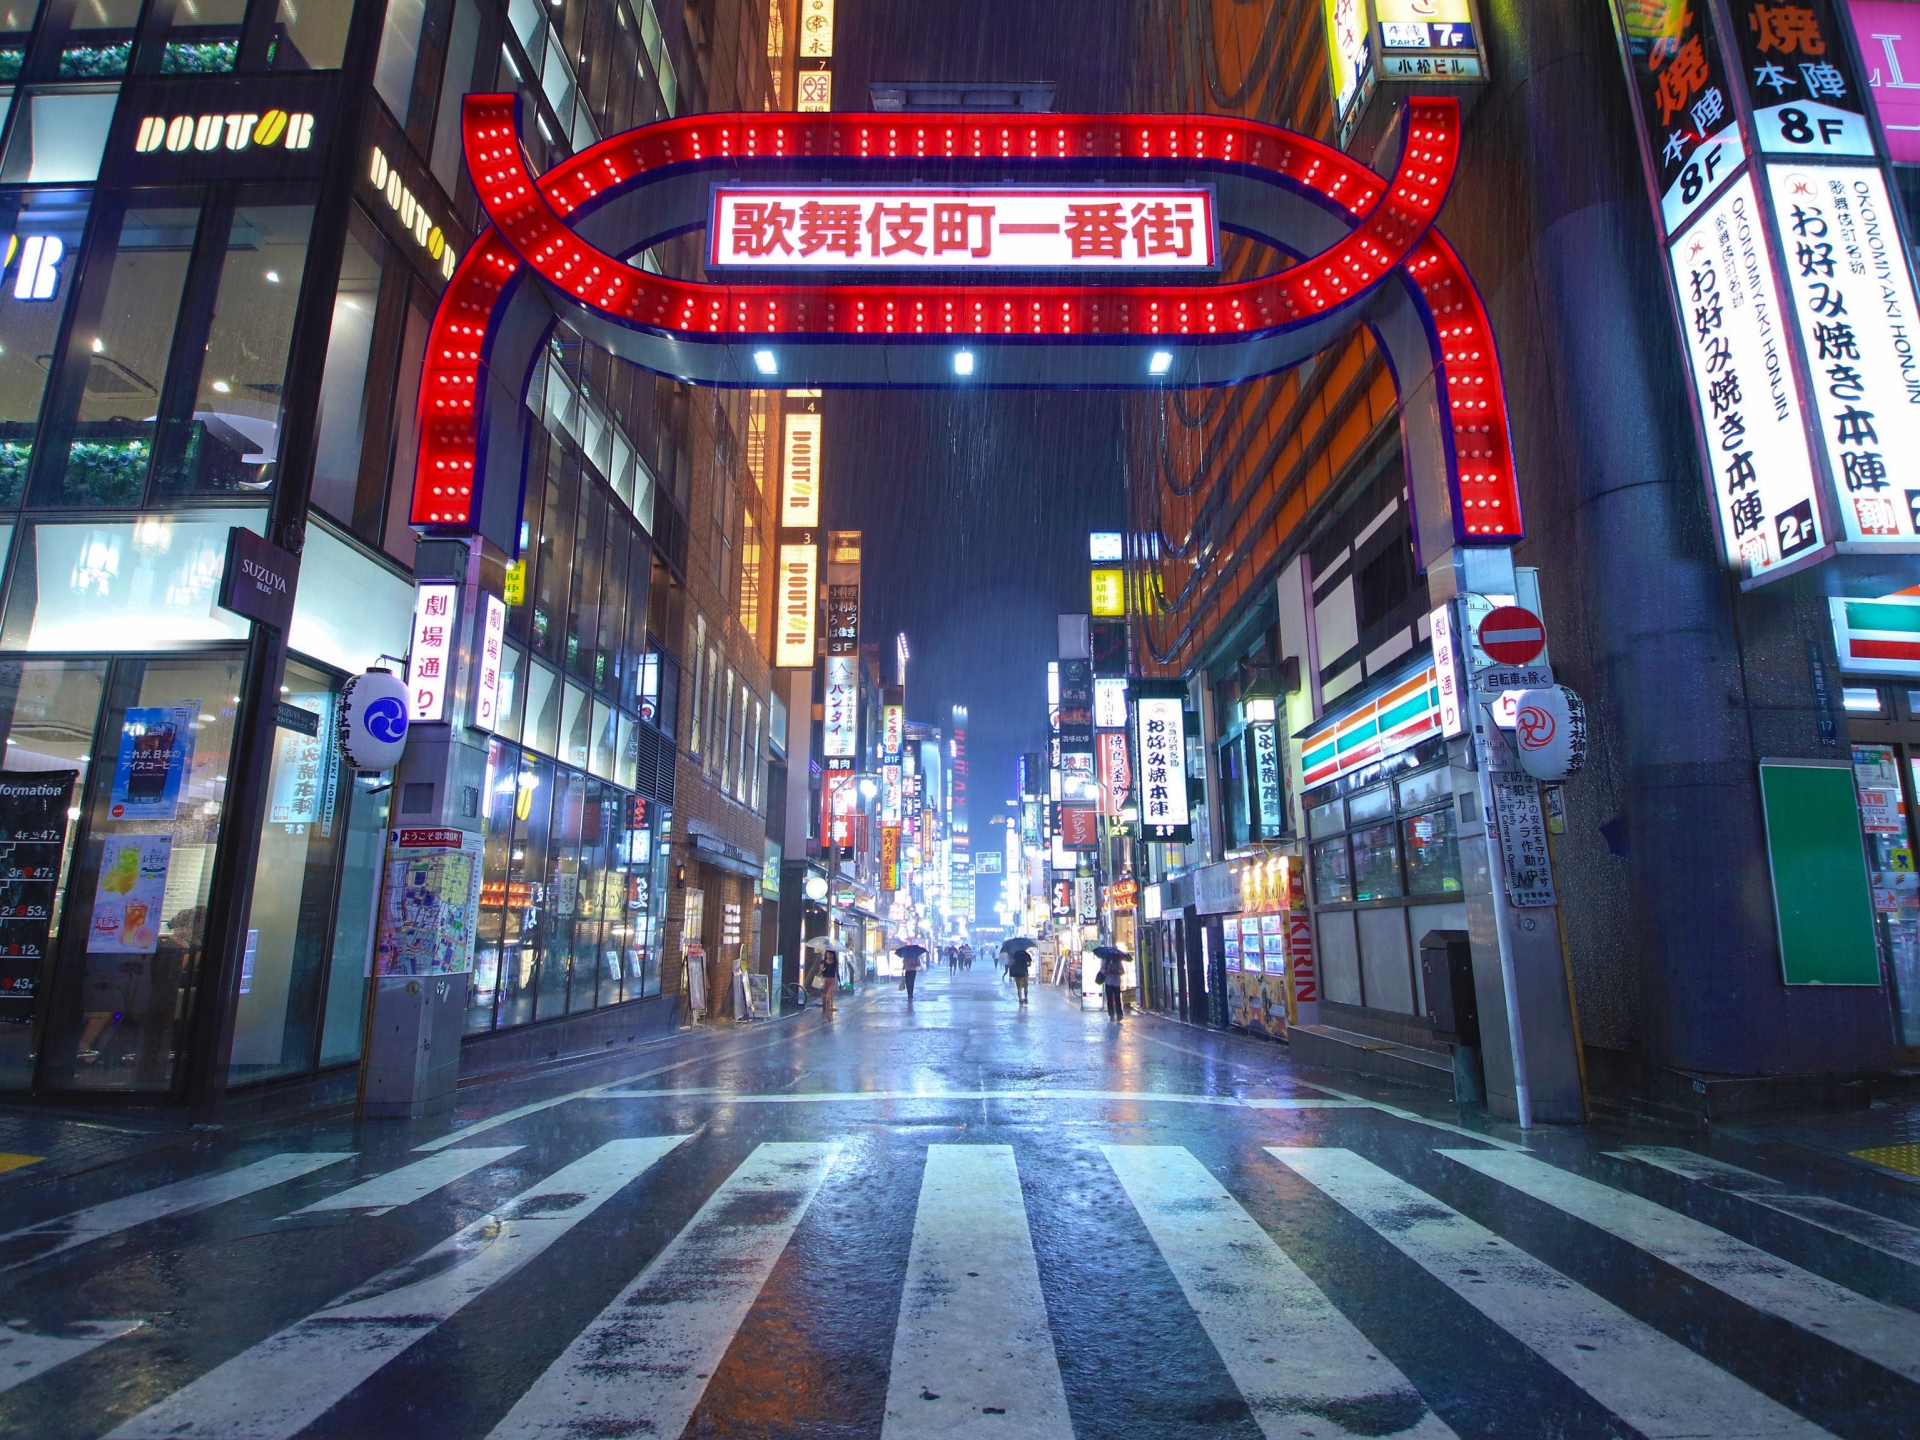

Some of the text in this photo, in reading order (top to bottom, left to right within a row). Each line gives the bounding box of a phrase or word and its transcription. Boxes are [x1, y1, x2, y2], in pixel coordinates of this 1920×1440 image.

[1433, 24, 1463, 46] 7F
[820, 61, 826, 70] 7
[1398, 59, 1465, 74] 小松ビル
[1754, 61, 1846, 98] 本陣
[136, 110, 314, 152] DOUTOR
[1662, 86, 1724, 168] 本陣
[1778, 108, 1843, 144] 8F
[1680, 142, 1722, 205] 8F
[370, 146, 456, 280] DOUTOR
[732, 201, 1195, 258] 歌舞伎町一番街
[1828, 181, 1866, 275] 歌舞伎町名物
[1854, 181, 1902, 318] OKONOMIYAKI
[1732, 198, 1789, 422] OKONOMIYAKI HONJIN
[1791, 204, 1890, 492] お好み焼き本陣
[807, 403, 815, 412] 4
[1690, 259, 1766, 540] お好み焼き本陣
[790, 431, 812, 508] DOUTOR
[803, 534, 811, 544] 3
[1779, 516, 1813, 551] 2F
[242, 559, 286, 593] SUZUYA
[786, 563, 808, 645] DOUTOR
[418, 595, 447, 709] 劇場通り
[482, 608, 501, 718] 劇場通り
[832, 643, 853, 651] 3F
[1435, 616, 1456, 726] 劇場通り
[1488, 671, 1548, 687] 自転車を除く
[277, 716, 308, 731] ENTRANCE
[830, 684, 844, 735] バンタイ
[1820, 721, 1832, 730] 17
[123, 750, 181, 759] これが、日本の
[829, 759, 850, 769] 焼肉
[884, 755, 900, 764] B1F
[1110, 735, 1126, 812] 焼鳥釜めし
[15, 831, 28, 839] 4F
[1523, 768, 1549, 887] なさまの安全を守ります
[9, 868, 22, 877] 3F
[2, 906, 15, 915] 2F
[1290, 916, 1316, 1002] KIRIN
